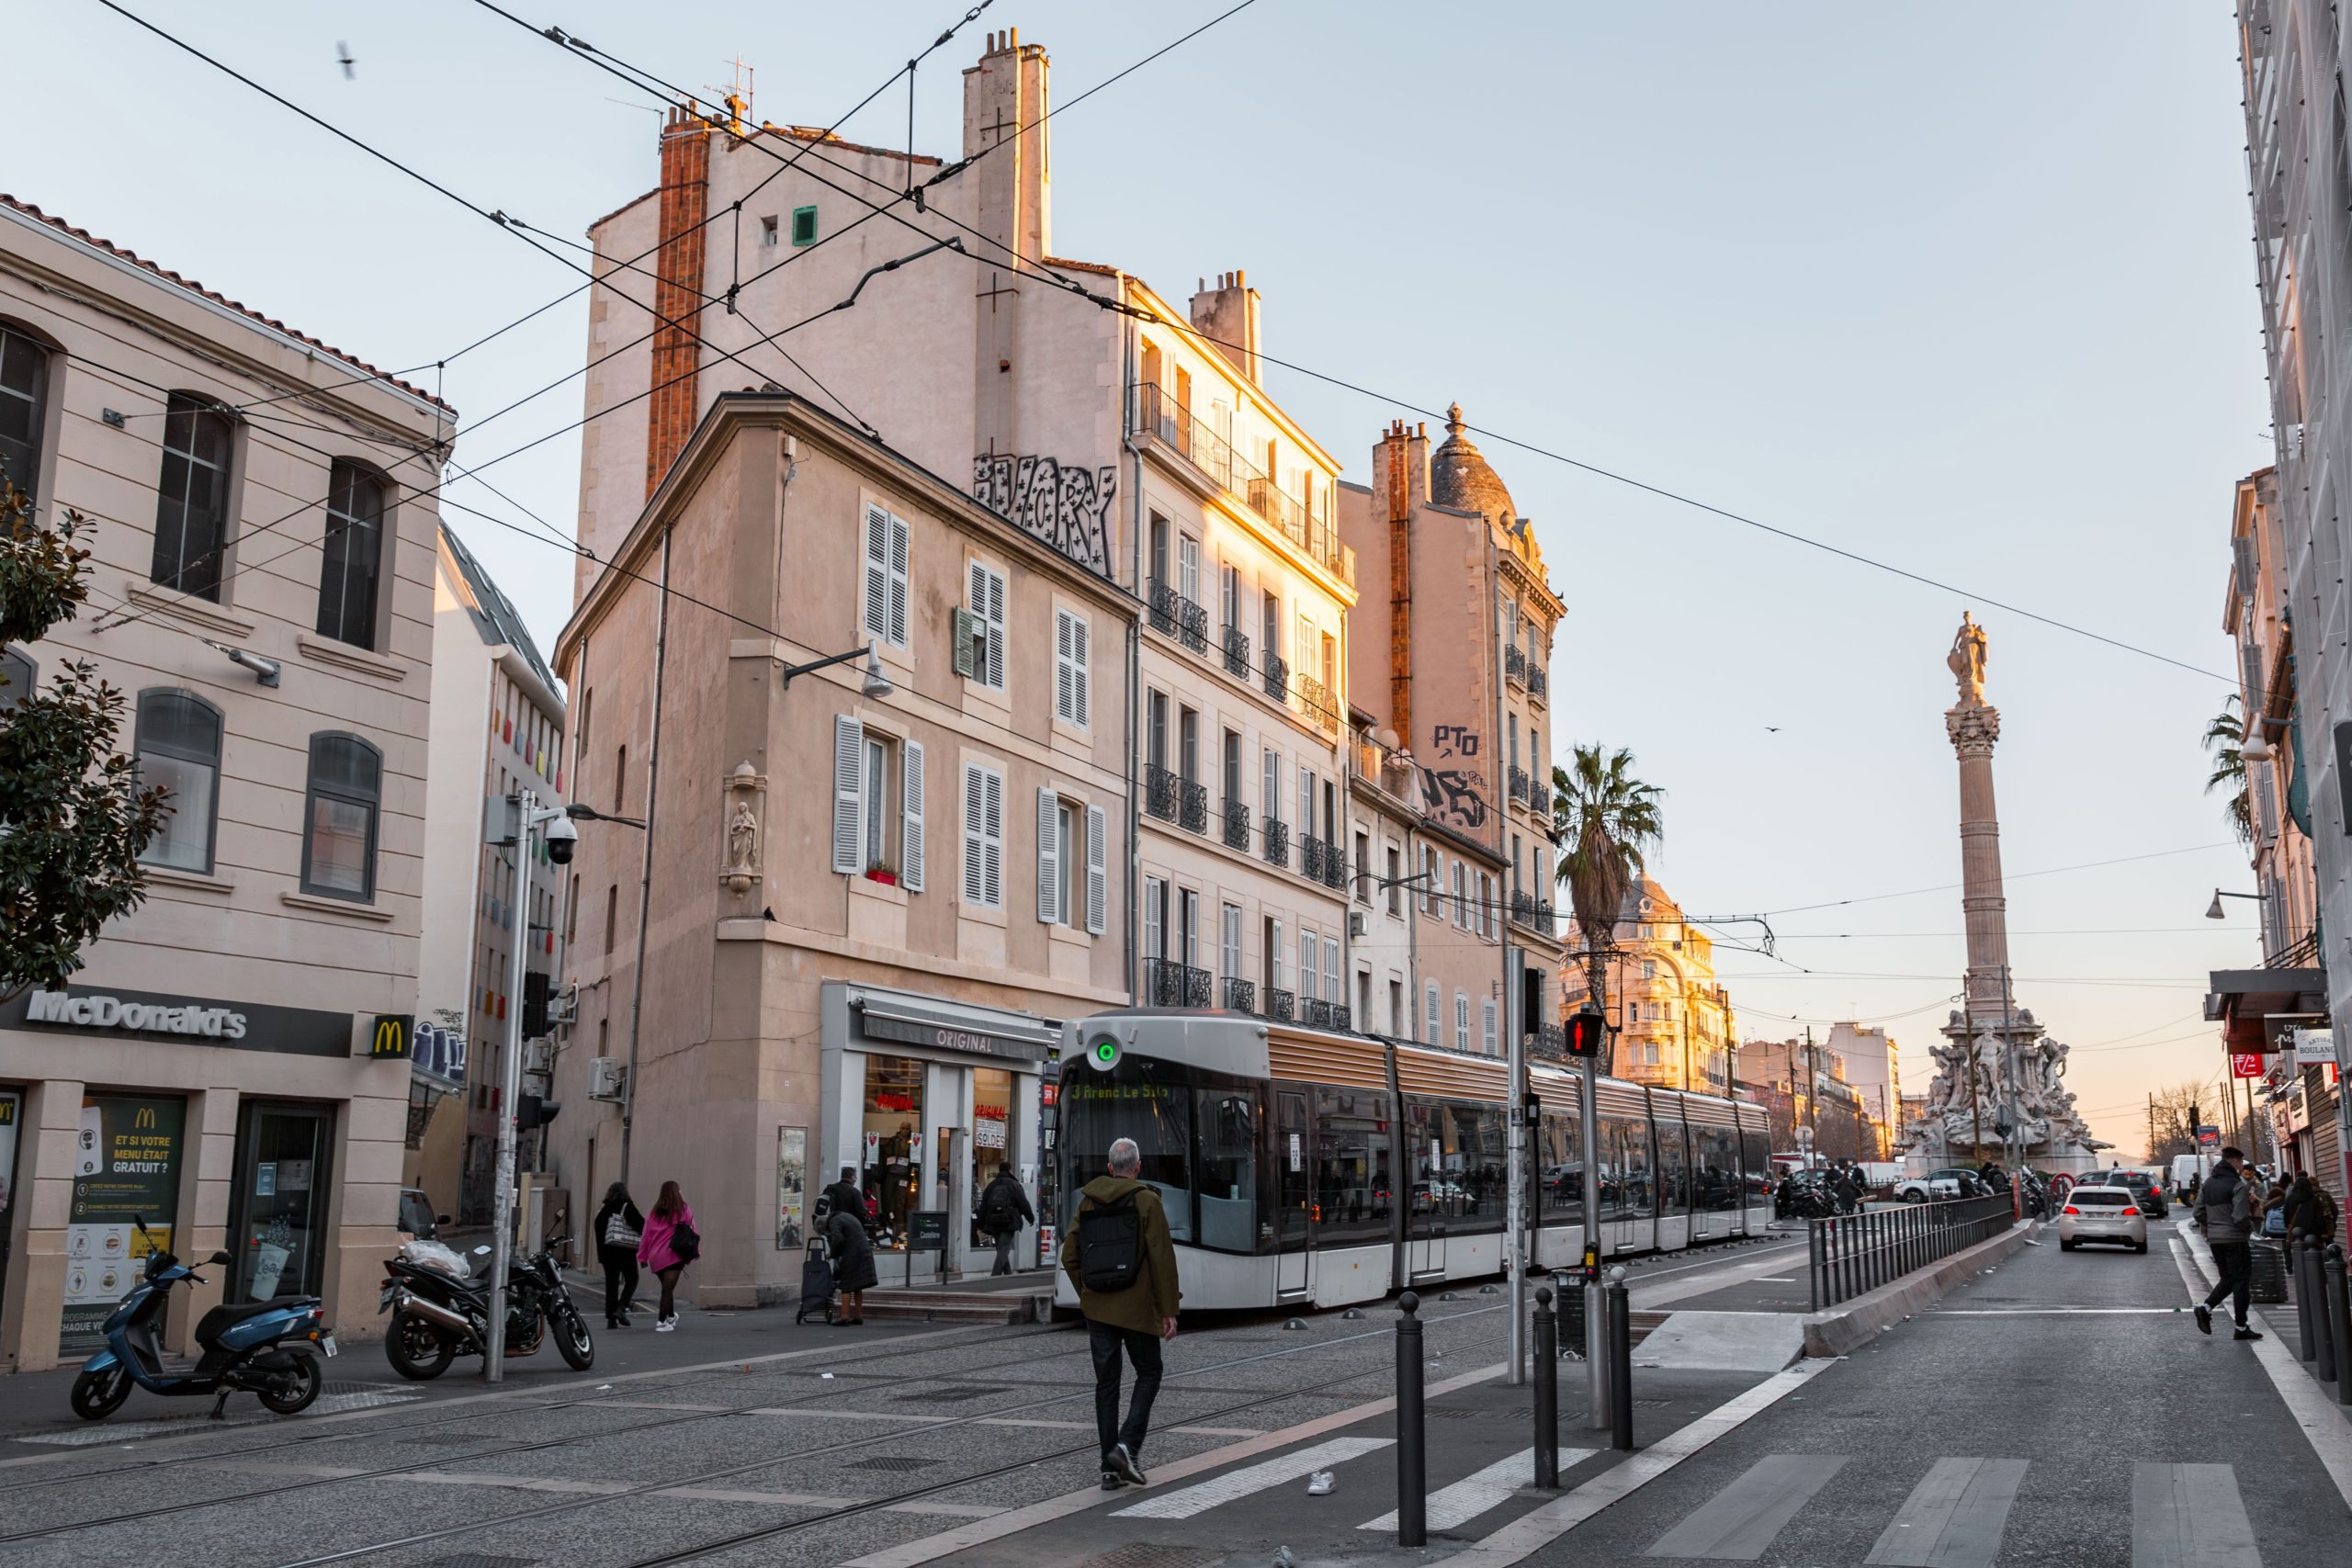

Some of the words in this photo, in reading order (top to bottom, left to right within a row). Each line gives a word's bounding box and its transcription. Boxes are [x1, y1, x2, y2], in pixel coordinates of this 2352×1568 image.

[26, 989, 247, 1039] McDonald's
[937, 1030, 992, 1053] ORIGINAL
[1071, 1084, 1080, 1100] 3
[1083, 1085, 1119, 1099] Arenc
[1123, 1084, 1138, 1098] Le
[975, 1104, 1007, 1119] ORIGINAL
[116, 1134, 128, 1145] ET
[130, 1135, 139, 1146] SI
[141, 1135, 171, 1146] VOTRE
[978, 1132, 1005, 1148] SOLDES
[114, 1149, 141, 1159] MENU
[143, 1147, 169, 1160] ÉTAIT
[113, 1161, 160, 1173] GRATUIT
[162, 1162, 168, 1173] ?
[62, 1322, 92, 1332] HAQUE
